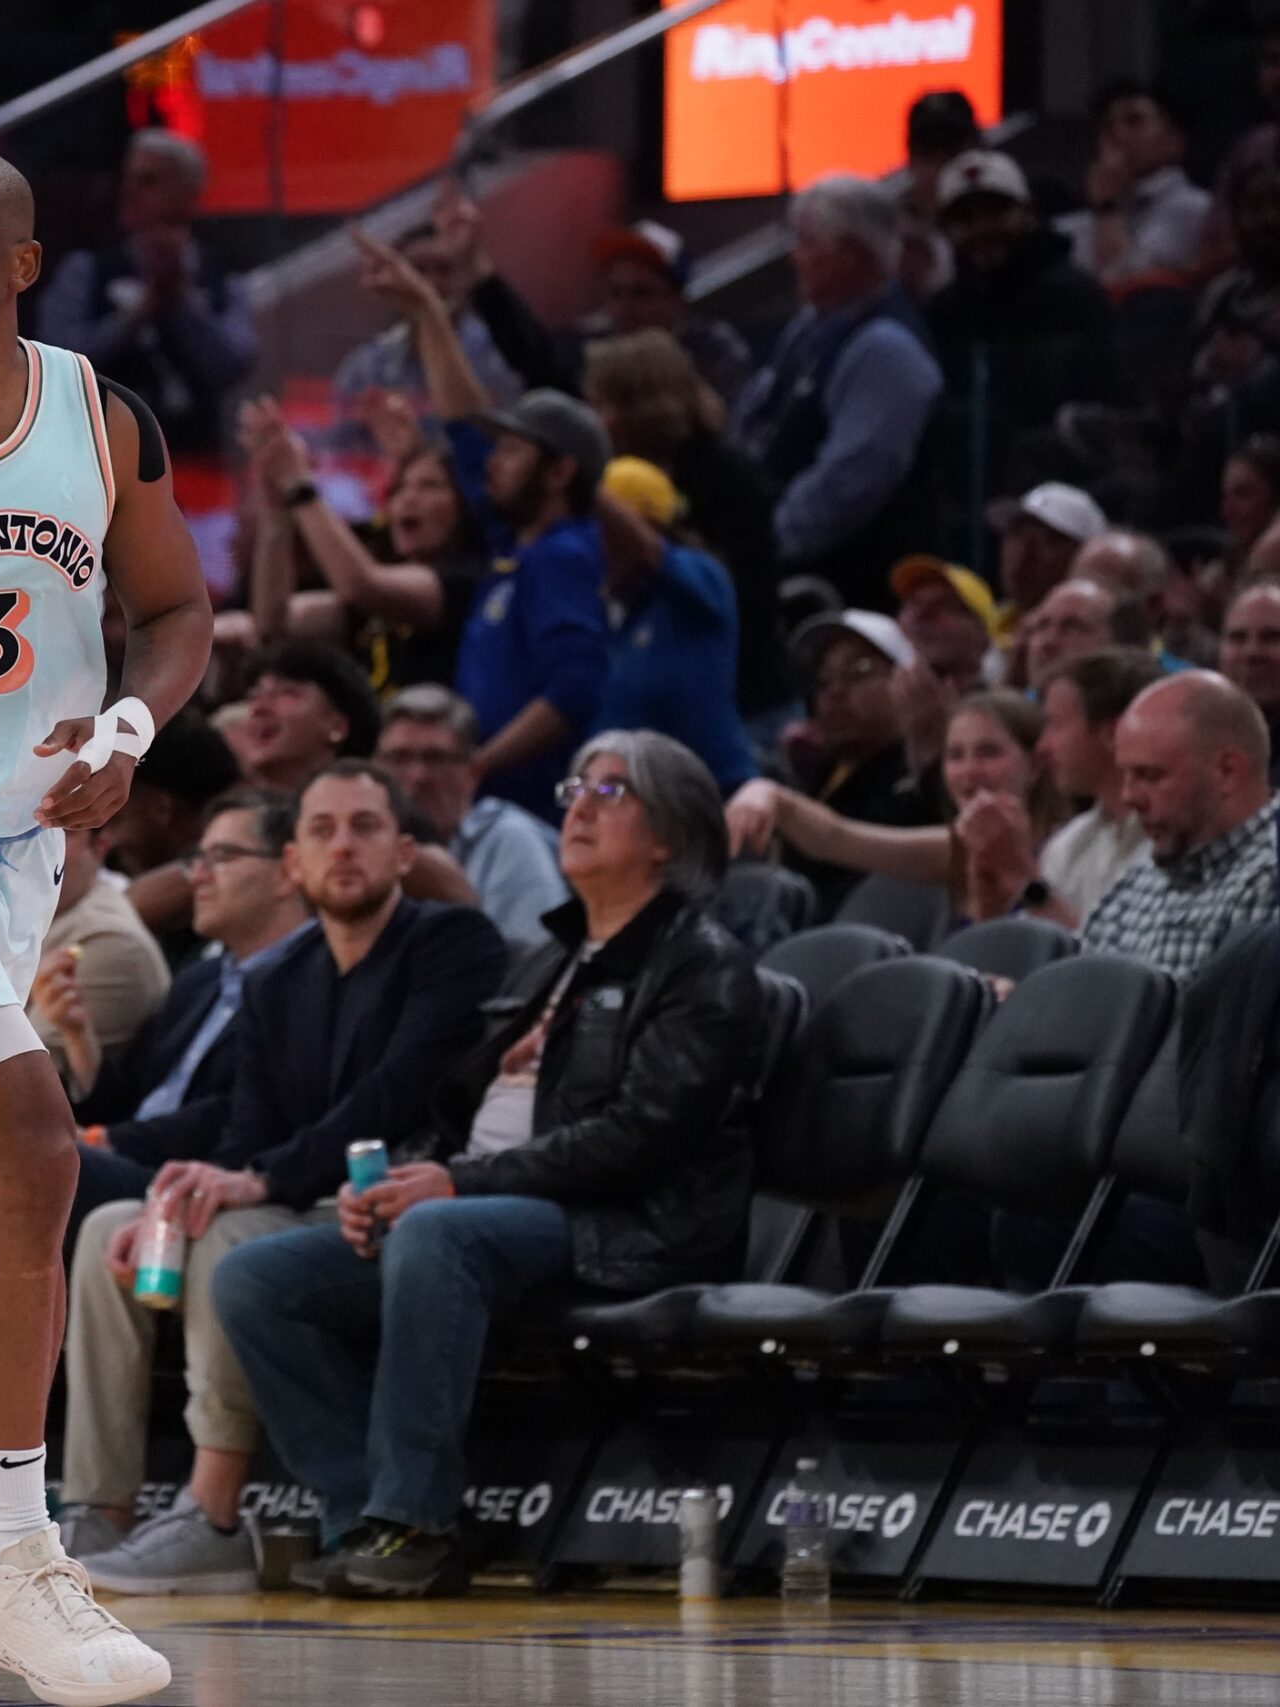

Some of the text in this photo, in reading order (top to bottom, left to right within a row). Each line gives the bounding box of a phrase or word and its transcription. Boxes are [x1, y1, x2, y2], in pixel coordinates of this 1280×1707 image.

[239, 1483, 323, 1519] CHAS
[586, 1487, 682, 1523] CHAS
[954, 1500, 1079, 1541] CHASE
